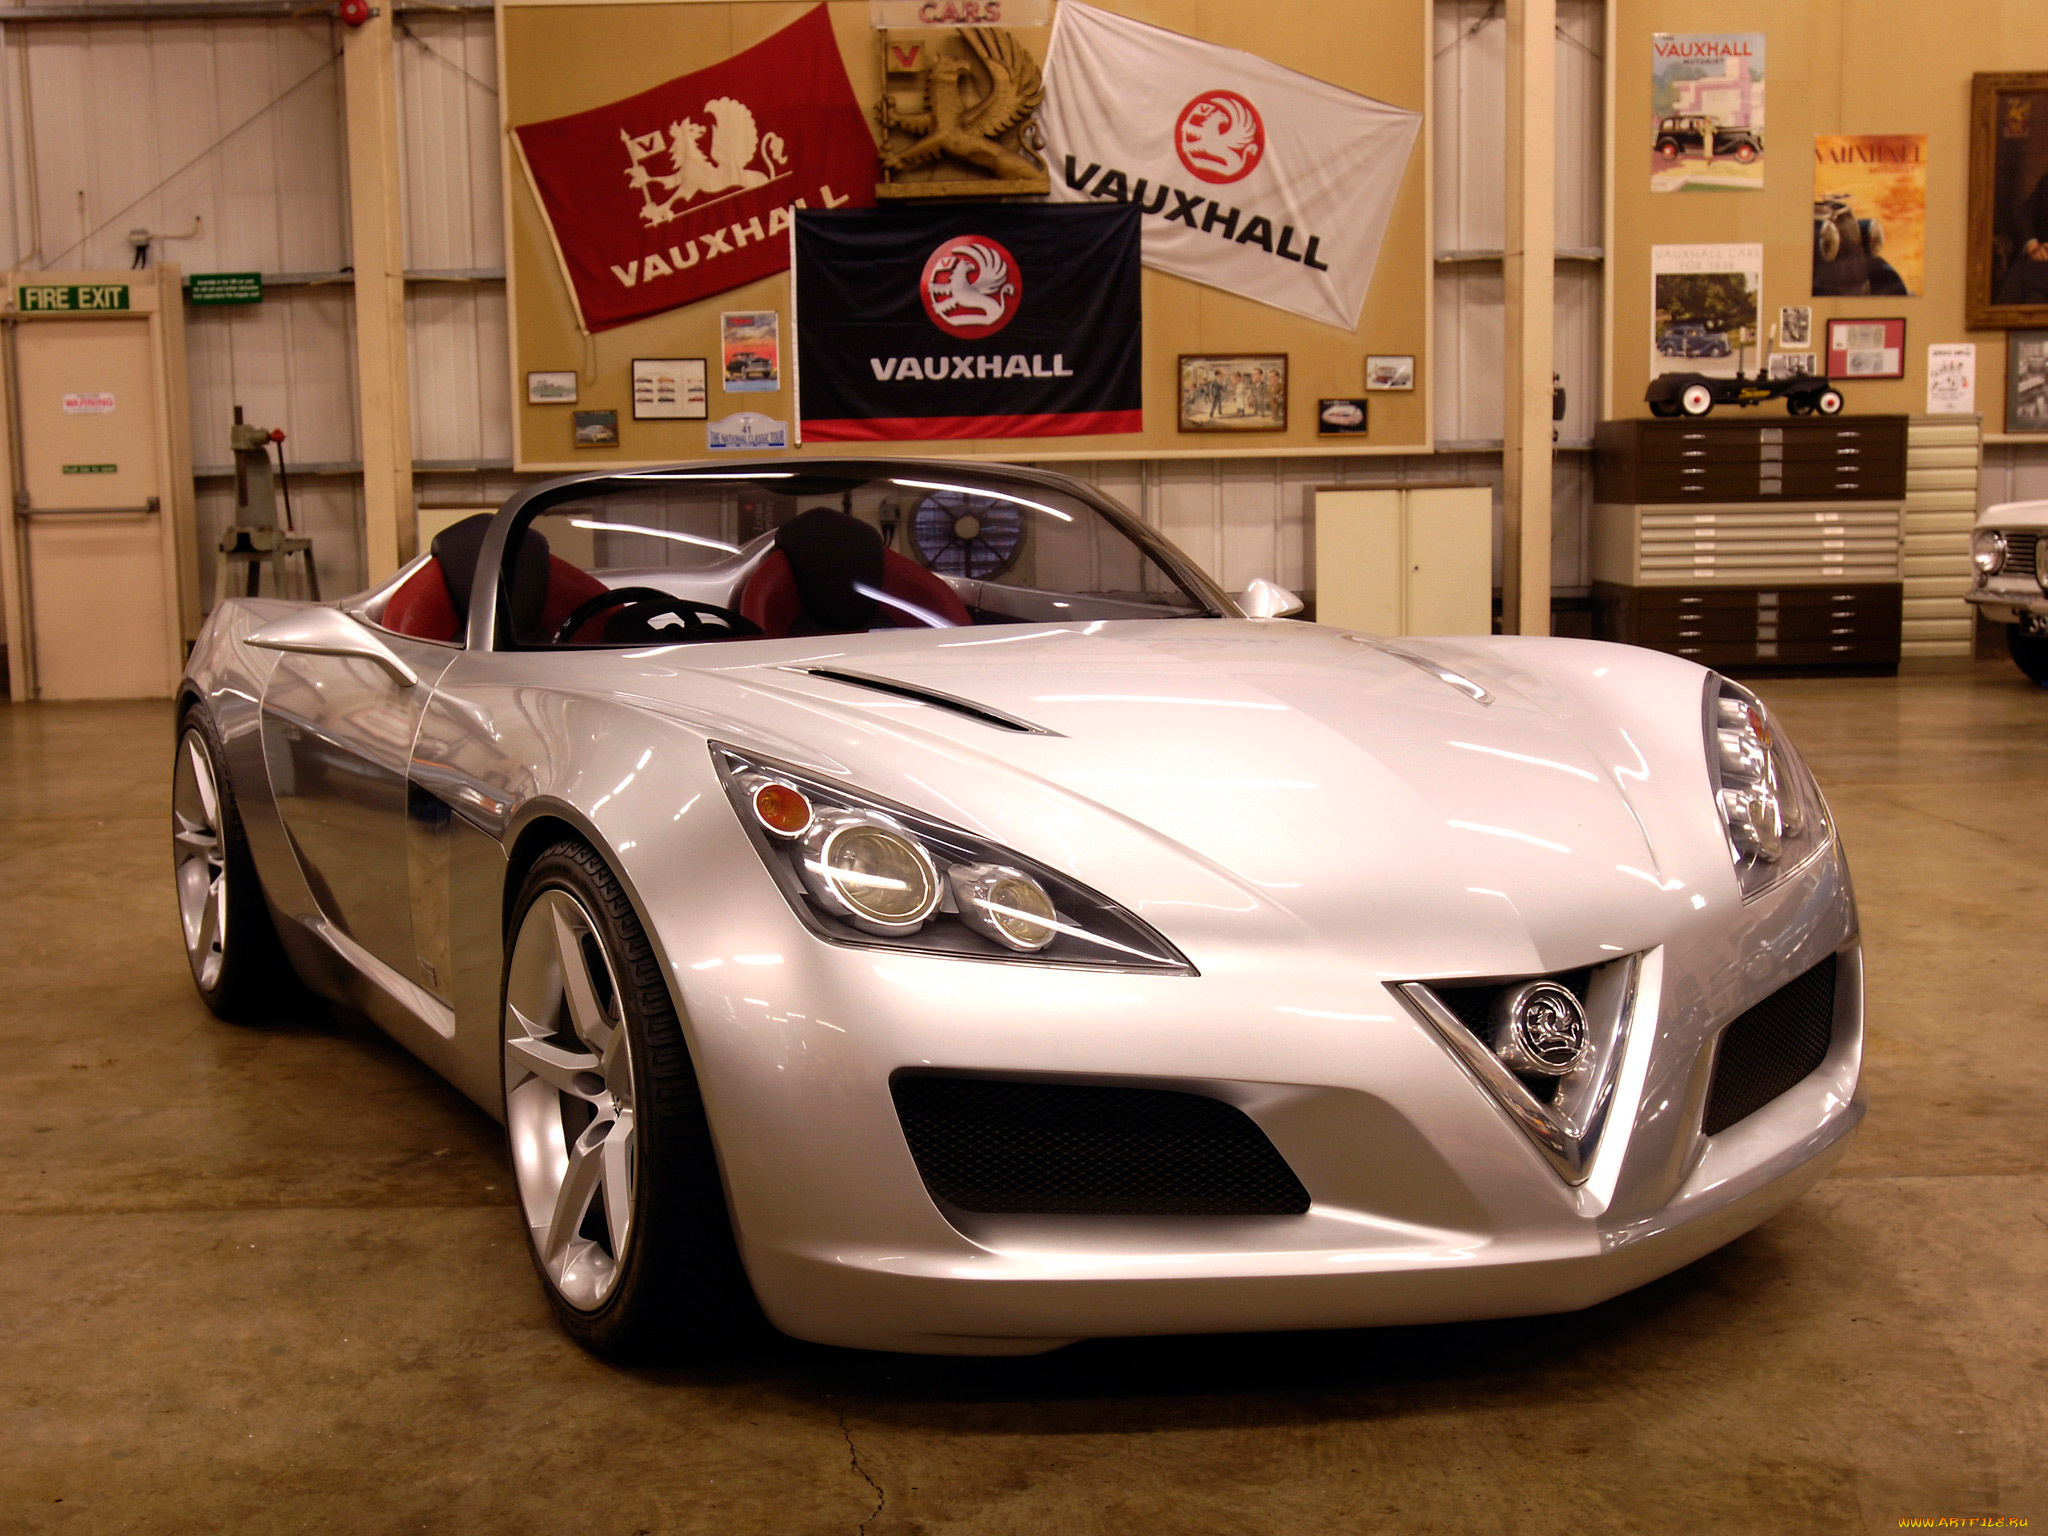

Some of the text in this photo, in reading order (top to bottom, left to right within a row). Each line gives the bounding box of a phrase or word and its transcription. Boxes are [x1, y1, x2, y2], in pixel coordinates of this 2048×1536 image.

[919, 2, 1001, 23] CARS
[892, 45, 921, 68] V
[1654, 41, 1753, 57] VAUXHALL
[1065, 154, 1328, 272] VAUXHALL
[610, 184, 850, 288] VAUXHAL
[1654, 247, 1760, 260] VAUXHALL CARS
[1679, 260, 1703, 271] FOR
[25, 286, 123, 310] FIRE EXIT
[870, 353, 1074, 382] VAUXHALL
[742, 426, 752, 434] 41
